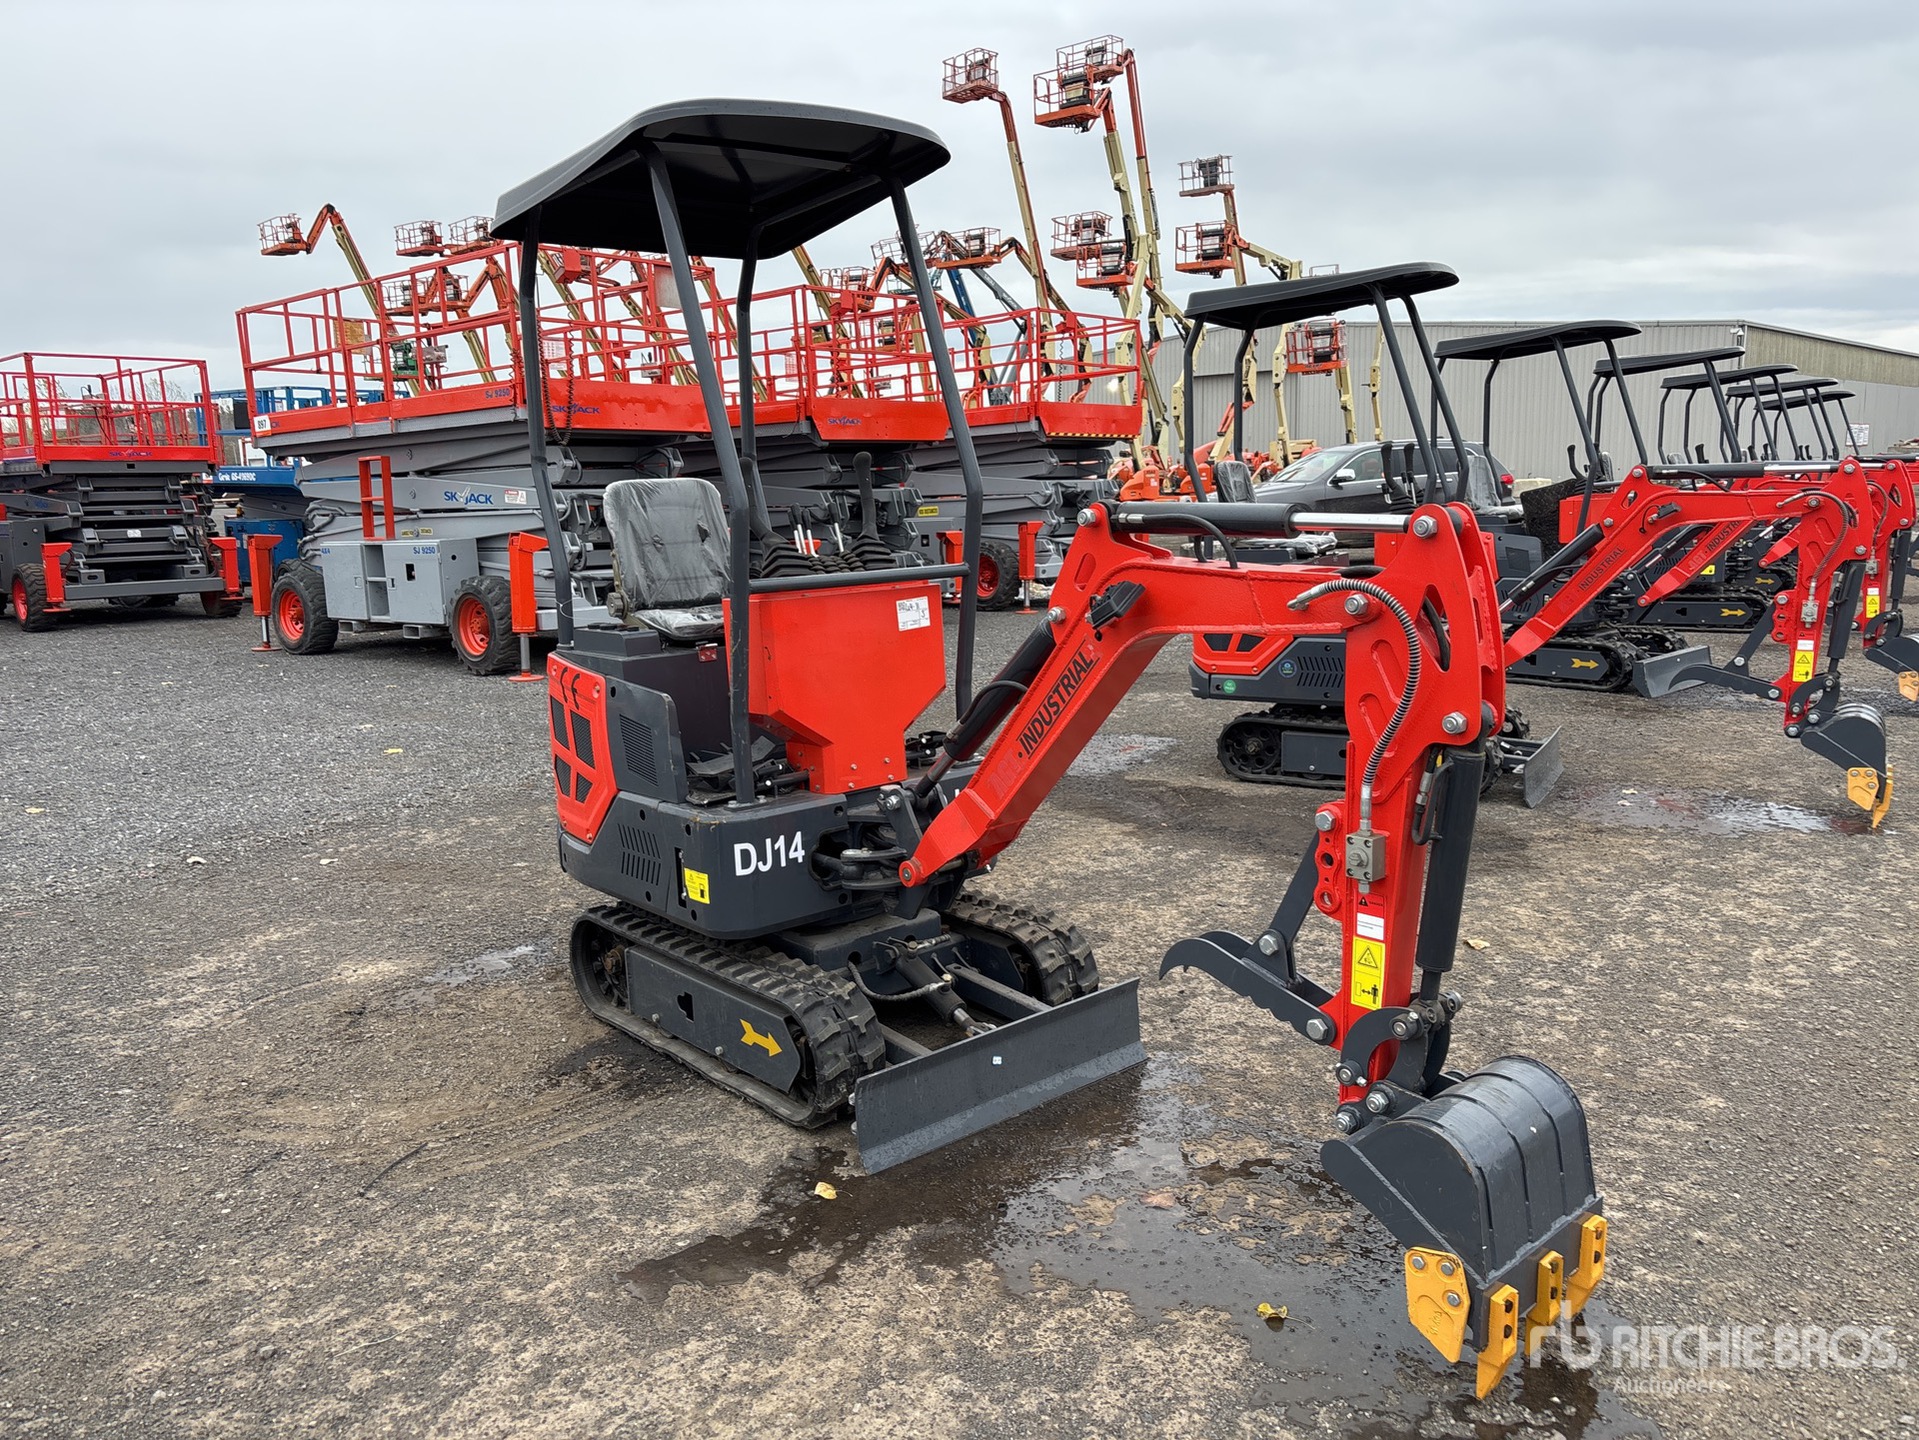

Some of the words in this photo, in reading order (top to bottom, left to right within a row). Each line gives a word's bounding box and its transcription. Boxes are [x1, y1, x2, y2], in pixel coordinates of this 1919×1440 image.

[443, 485, 494, 505] SKYJACK
[413, 546, 421, 555] SJ
[421, 545, 436, 555] 9250
[1578, 546, 1626, 592] INDUSTRIAL
[1018, 651, 1094, 756] INDUSTRIAL
[733, 830, 806, 877] DJ14
